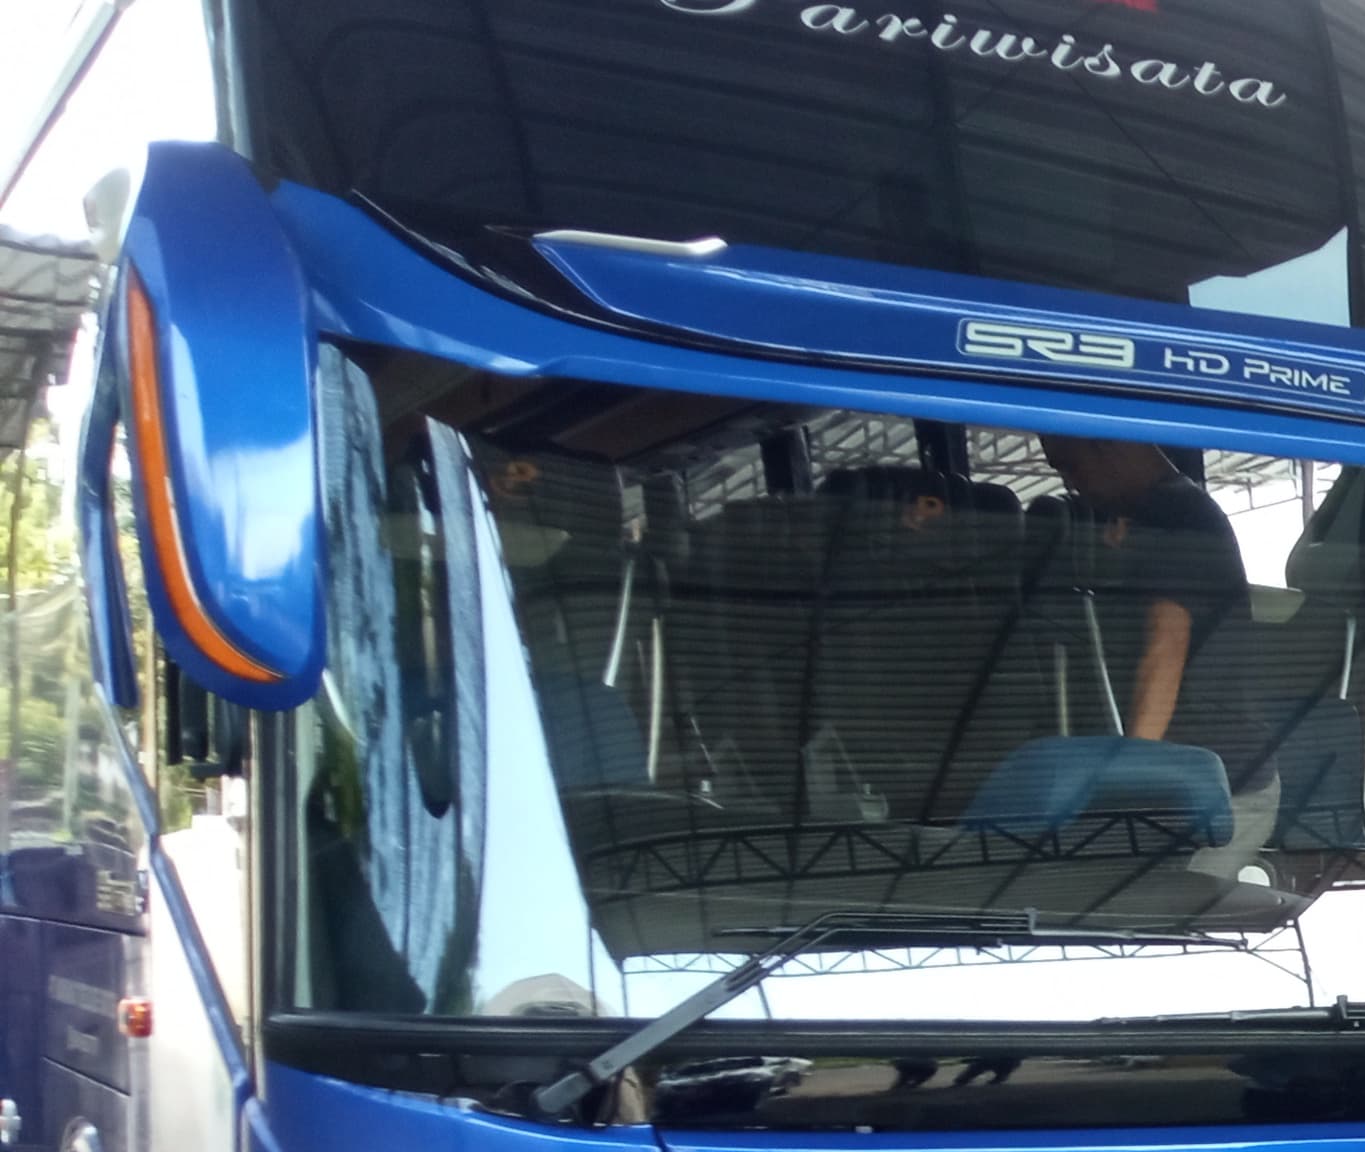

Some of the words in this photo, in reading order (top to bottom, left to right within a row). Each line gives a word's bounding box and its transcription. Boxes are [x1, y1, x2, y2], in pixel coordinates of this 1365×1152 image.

[660, 0, 1287, 108] ariwisata
[1163, 347, 1231, 376] HD
[1243, 357, 1352, 395] PRIME
